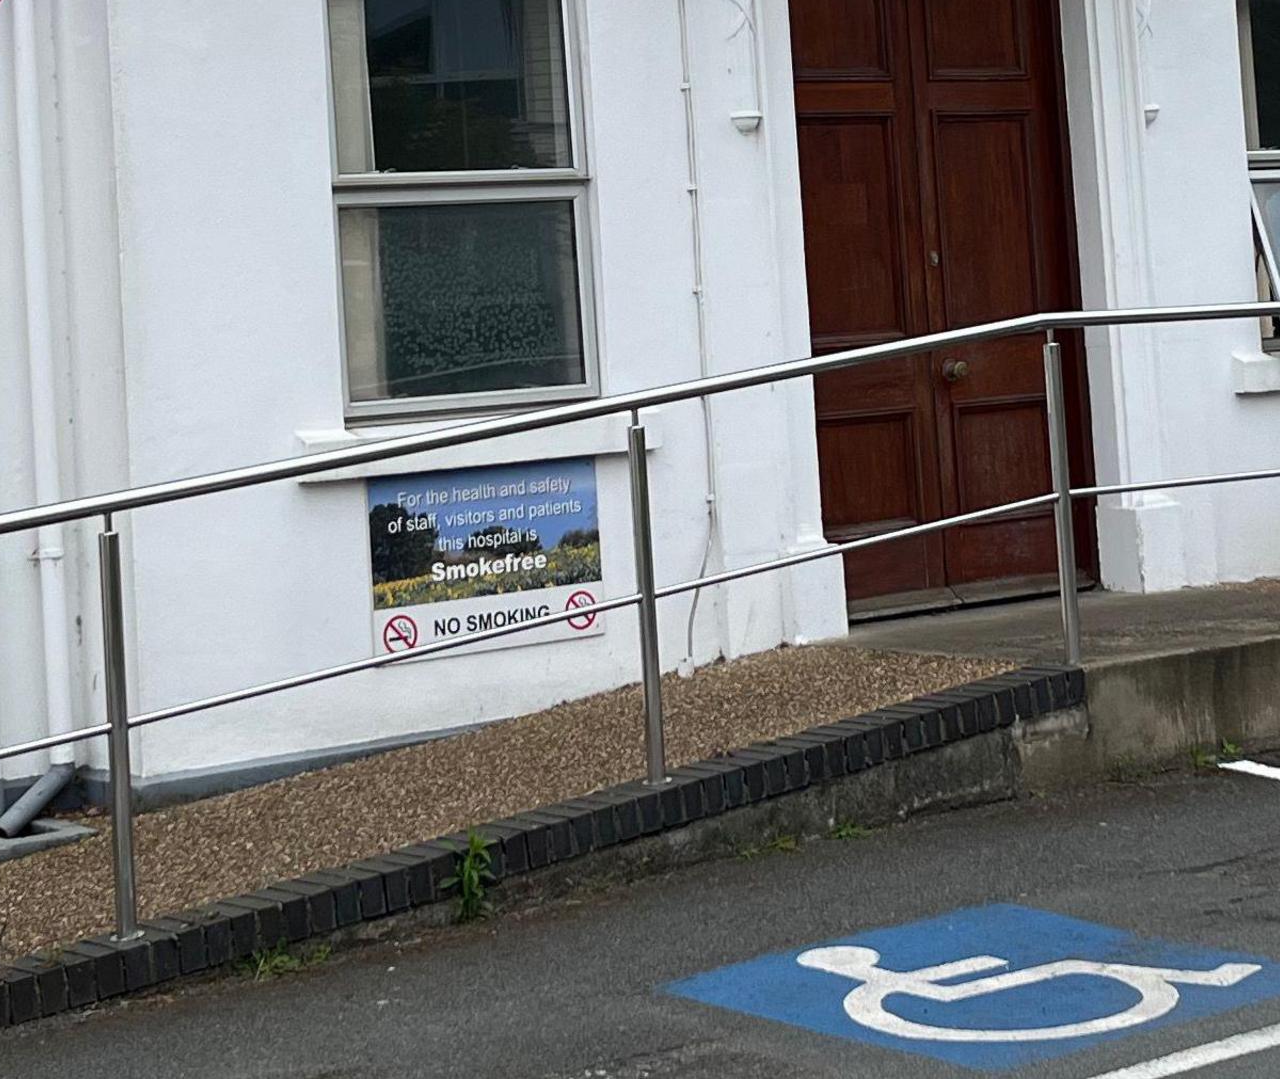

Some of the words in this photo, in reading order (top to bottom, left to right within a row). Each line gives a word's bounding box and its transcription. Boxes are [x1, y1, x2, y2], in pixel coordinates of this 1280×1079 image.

[397, 491, 421, 508] For
[426, 488, 448, 505] the
[452, 483, 496, 502] health
[500, 479, 526, 497] and
[529, 476, 571, 494] safety
[387, 517, 403, 534] of
[406, 512, 441, 531] staff,
[444, 509, 495, 527] visitors
[499, 504, 525, 521] and
[528, 499, 582, 520] patients
[438, 534, 464, 552] this
[468, 527, 522, 549] hospital
[525, 528, 538, 541] is
[431, 553, 548, 582] Smokefree
[433, 617, 461, 637] NO
[466, 605, 550, 632] SMOKING
